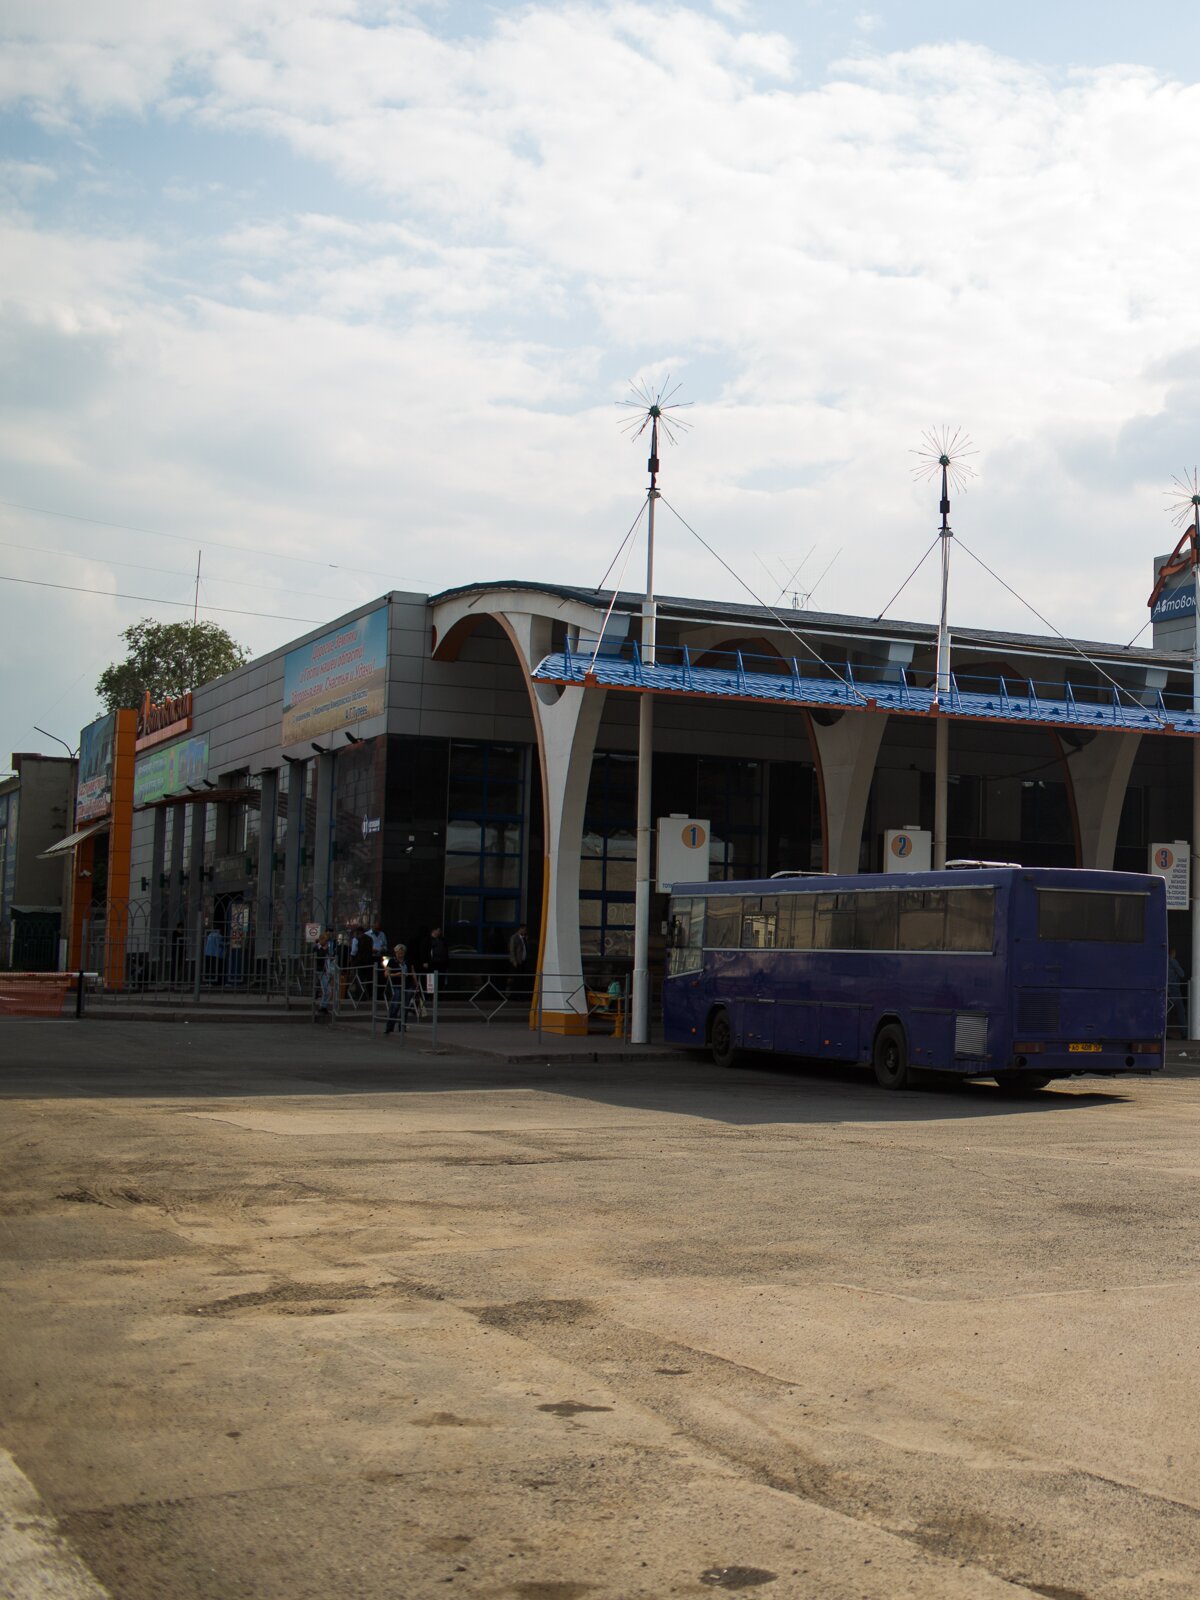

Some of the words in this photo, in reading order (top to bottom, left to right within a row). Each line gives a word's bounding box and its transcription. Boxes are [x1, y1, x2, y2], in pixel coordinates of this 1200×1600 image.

[690, 827, 697, 848] 1
[898, 837, 907, 857] 2
[1161, 850, 1168, 868] 3
